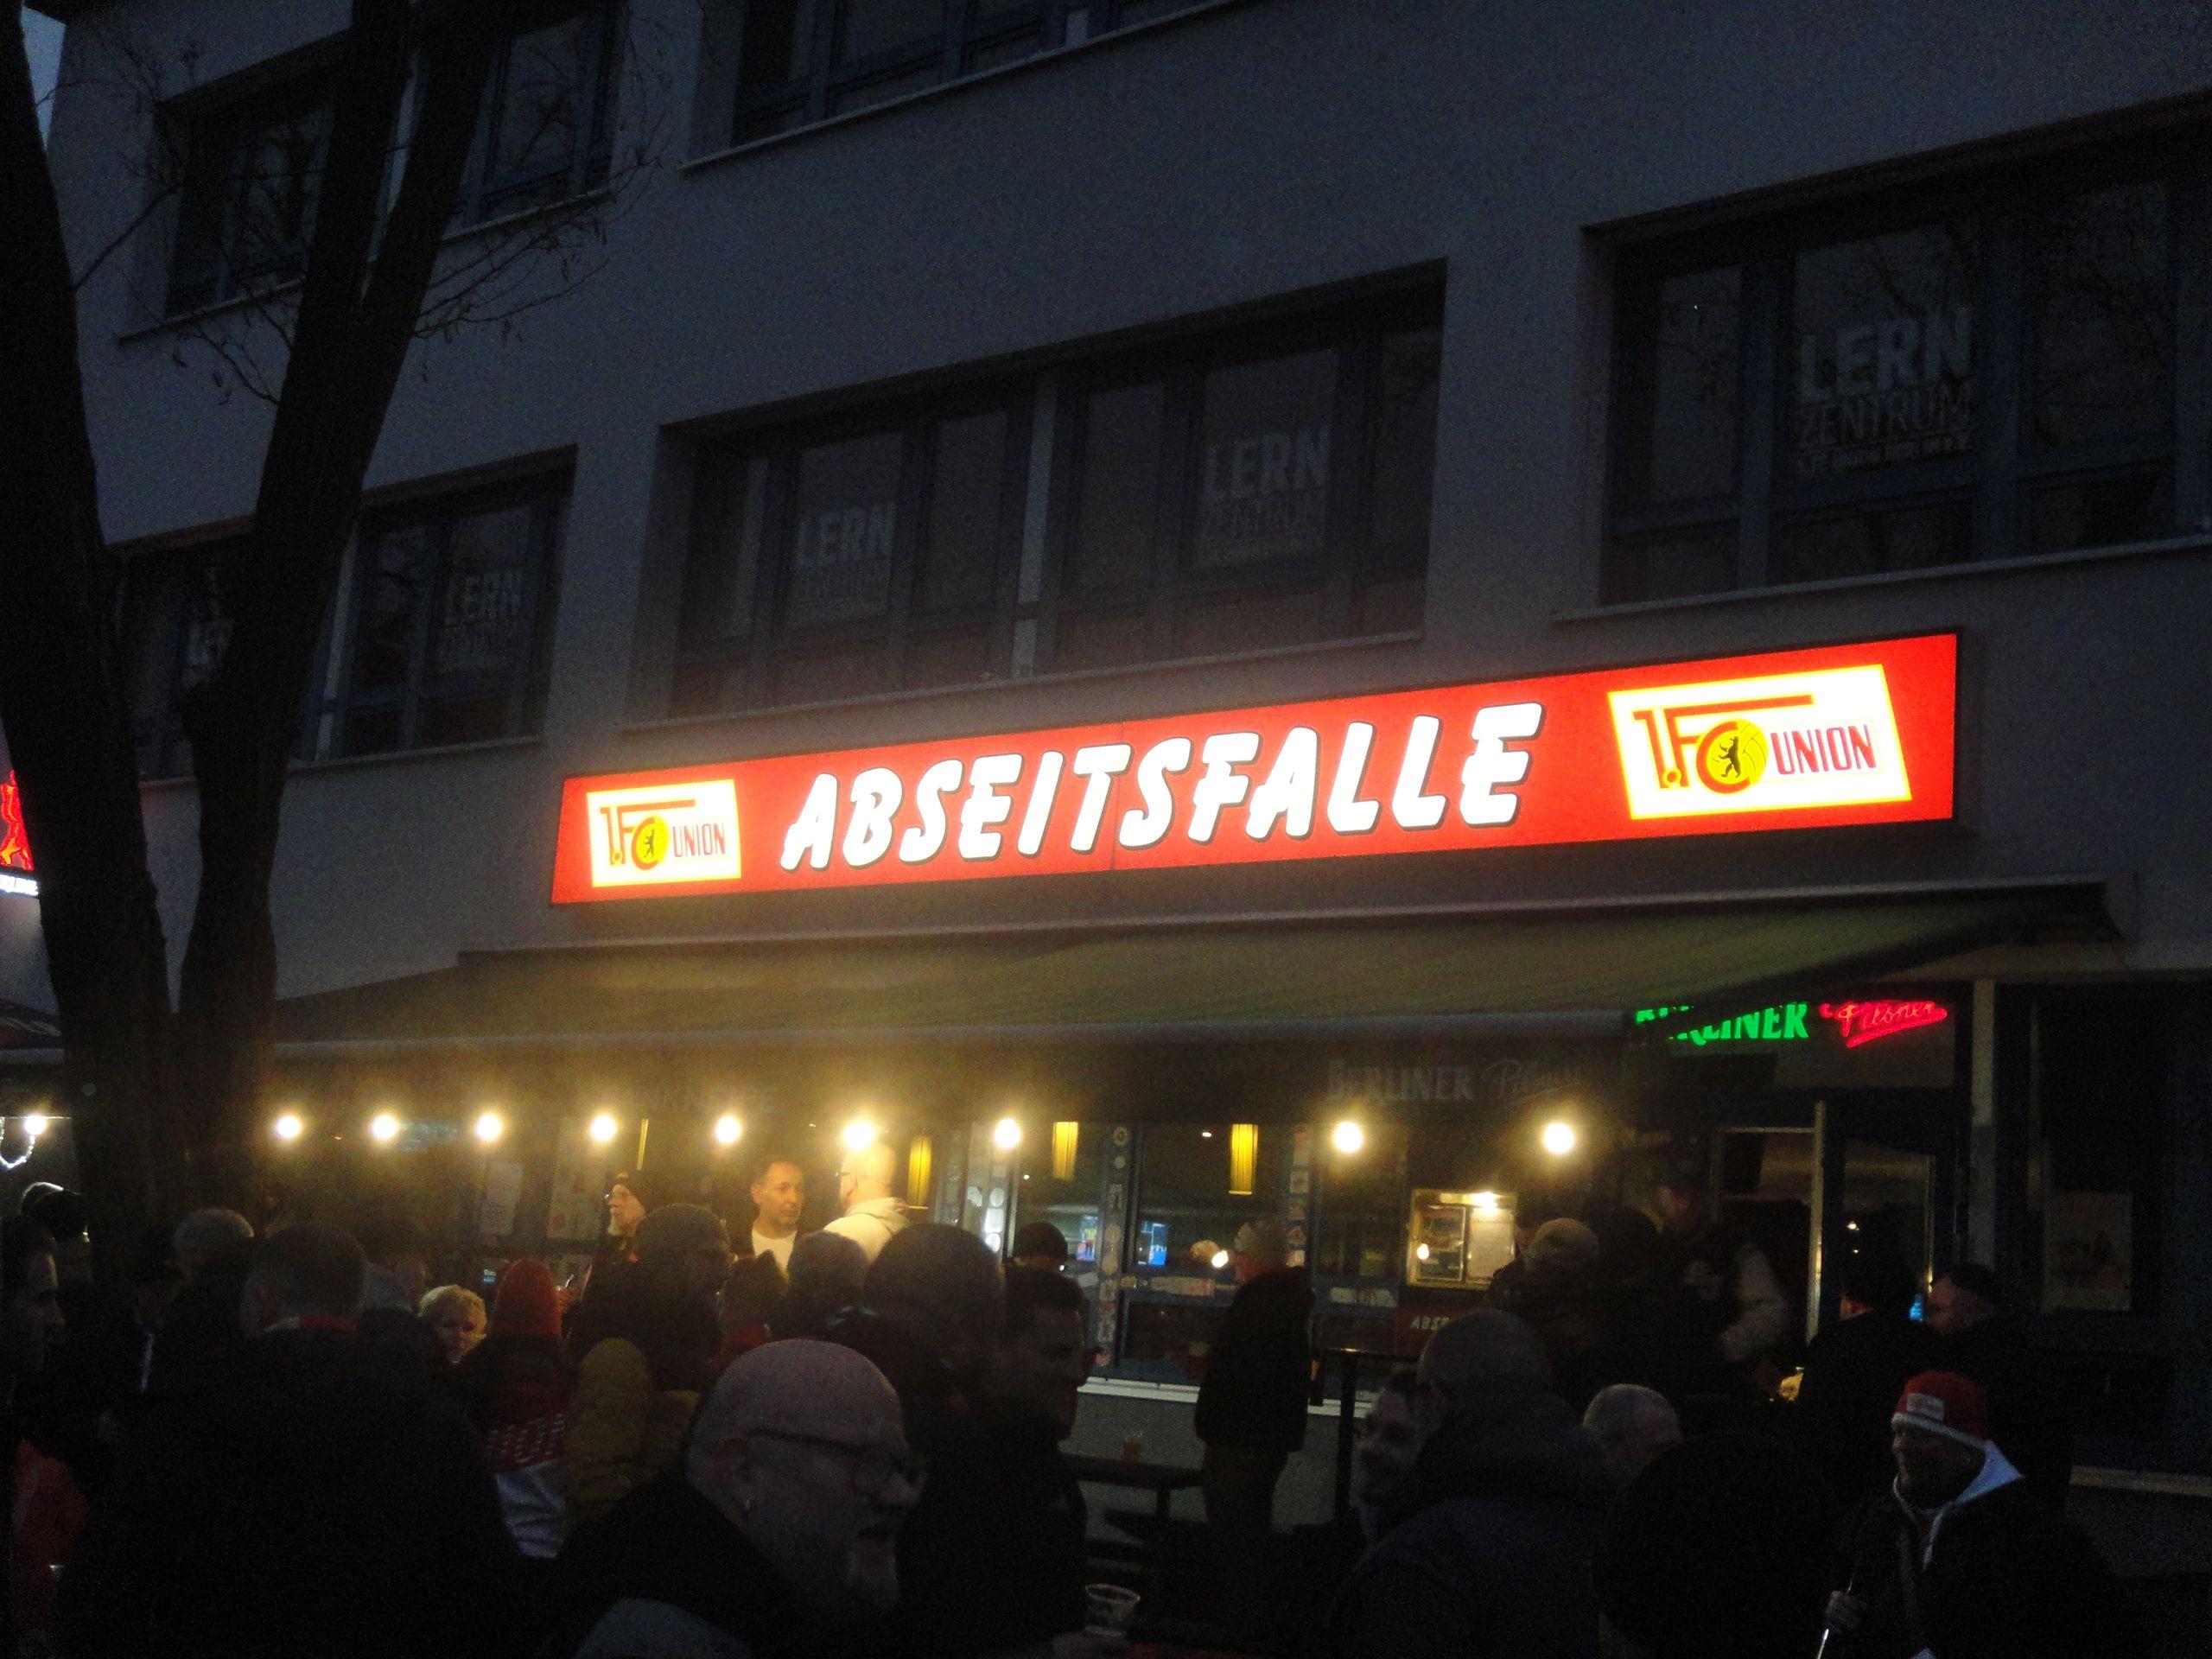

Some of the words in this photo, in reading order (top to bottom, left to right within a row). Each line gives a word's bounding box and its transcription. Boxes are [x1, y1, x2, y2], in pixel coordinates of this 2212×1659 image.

[1799, 302, 1971, 403] LERN
[1796, 380, 1972, 448] ZENTRUM
[1204, 424, 1331, 502] LERN
[796, 500, 896, 567] LERN
[444, 567, 523, 626] LERN
[1770, 723, 1878, 775] UNION
[779, 702, 1545, 872] ABSEITSFALLE
[672, 823, 727, 858] UNION
[1636, 1003, 1810, 1046] LINER
